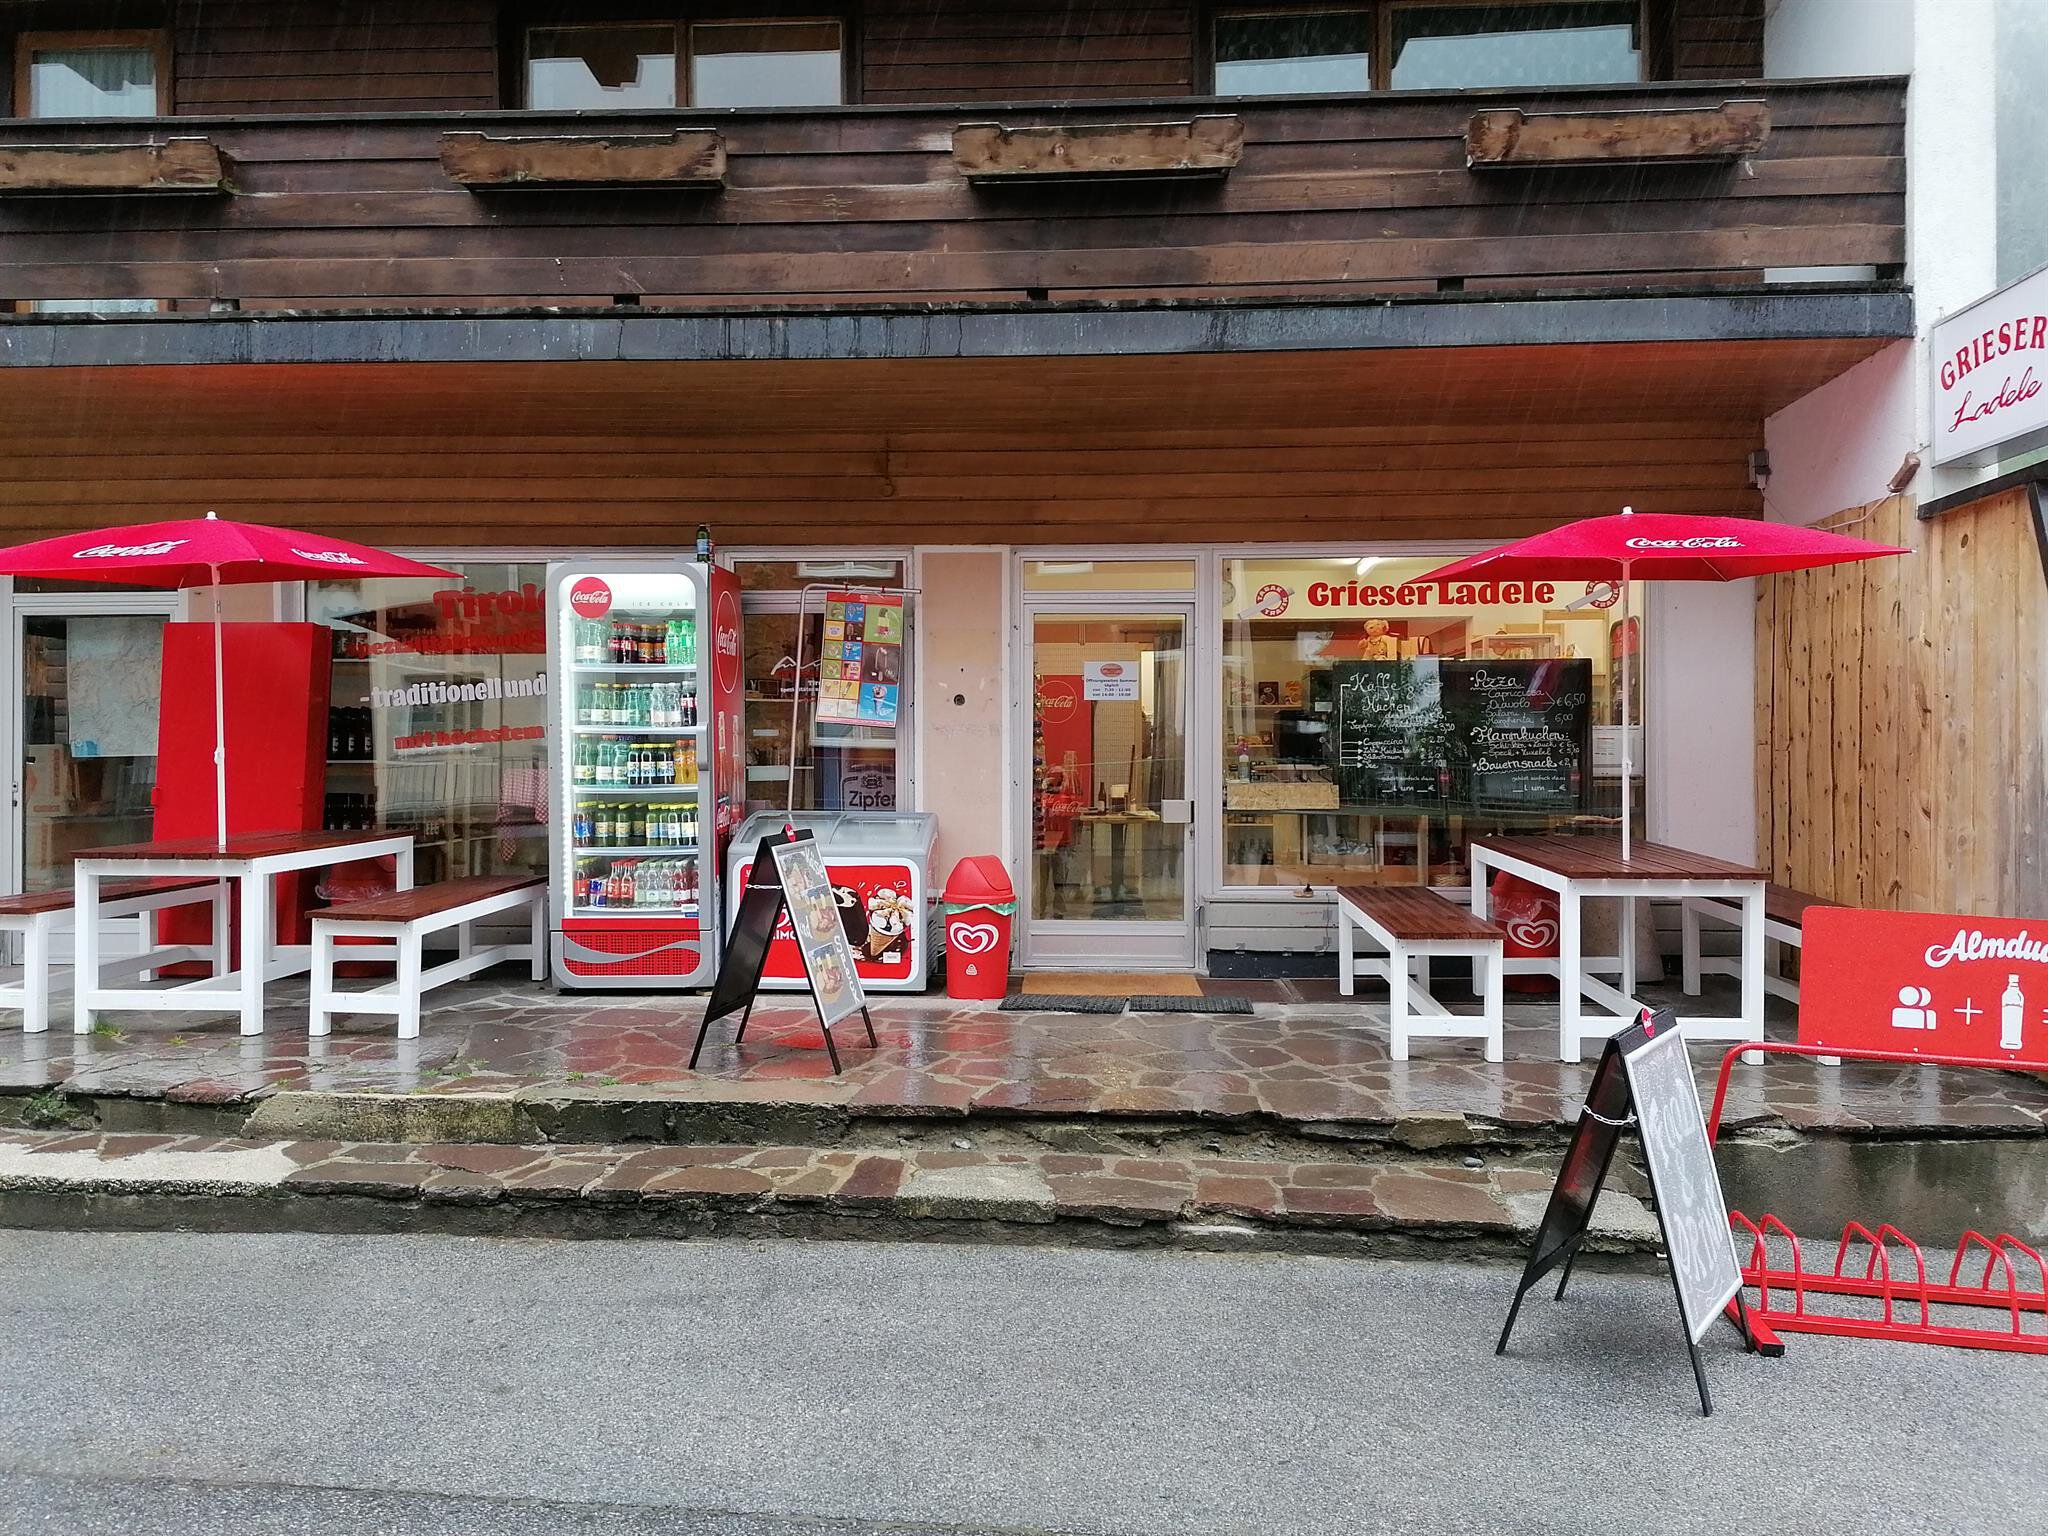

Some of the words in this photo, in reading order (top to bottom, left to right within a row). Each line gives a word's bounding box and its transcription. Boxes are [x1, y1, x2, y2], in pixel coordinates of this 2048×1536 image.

[1940, 315, 2048, 391] GRIESER
[1948, 366, 2042, 433] Ladele
[1625, 535, 1745, 549] Coca-Cola
[571, 590, 610, 604] Coca-Cola
[1307, 580, 1433, 607] Grieser
[1437, 580, 1555, 606] Ladele
[371, 677, 503, 708] traditionell
[503, 673, 547, 698] und
[1476, 756, 1558, 771] Bauernsnack
